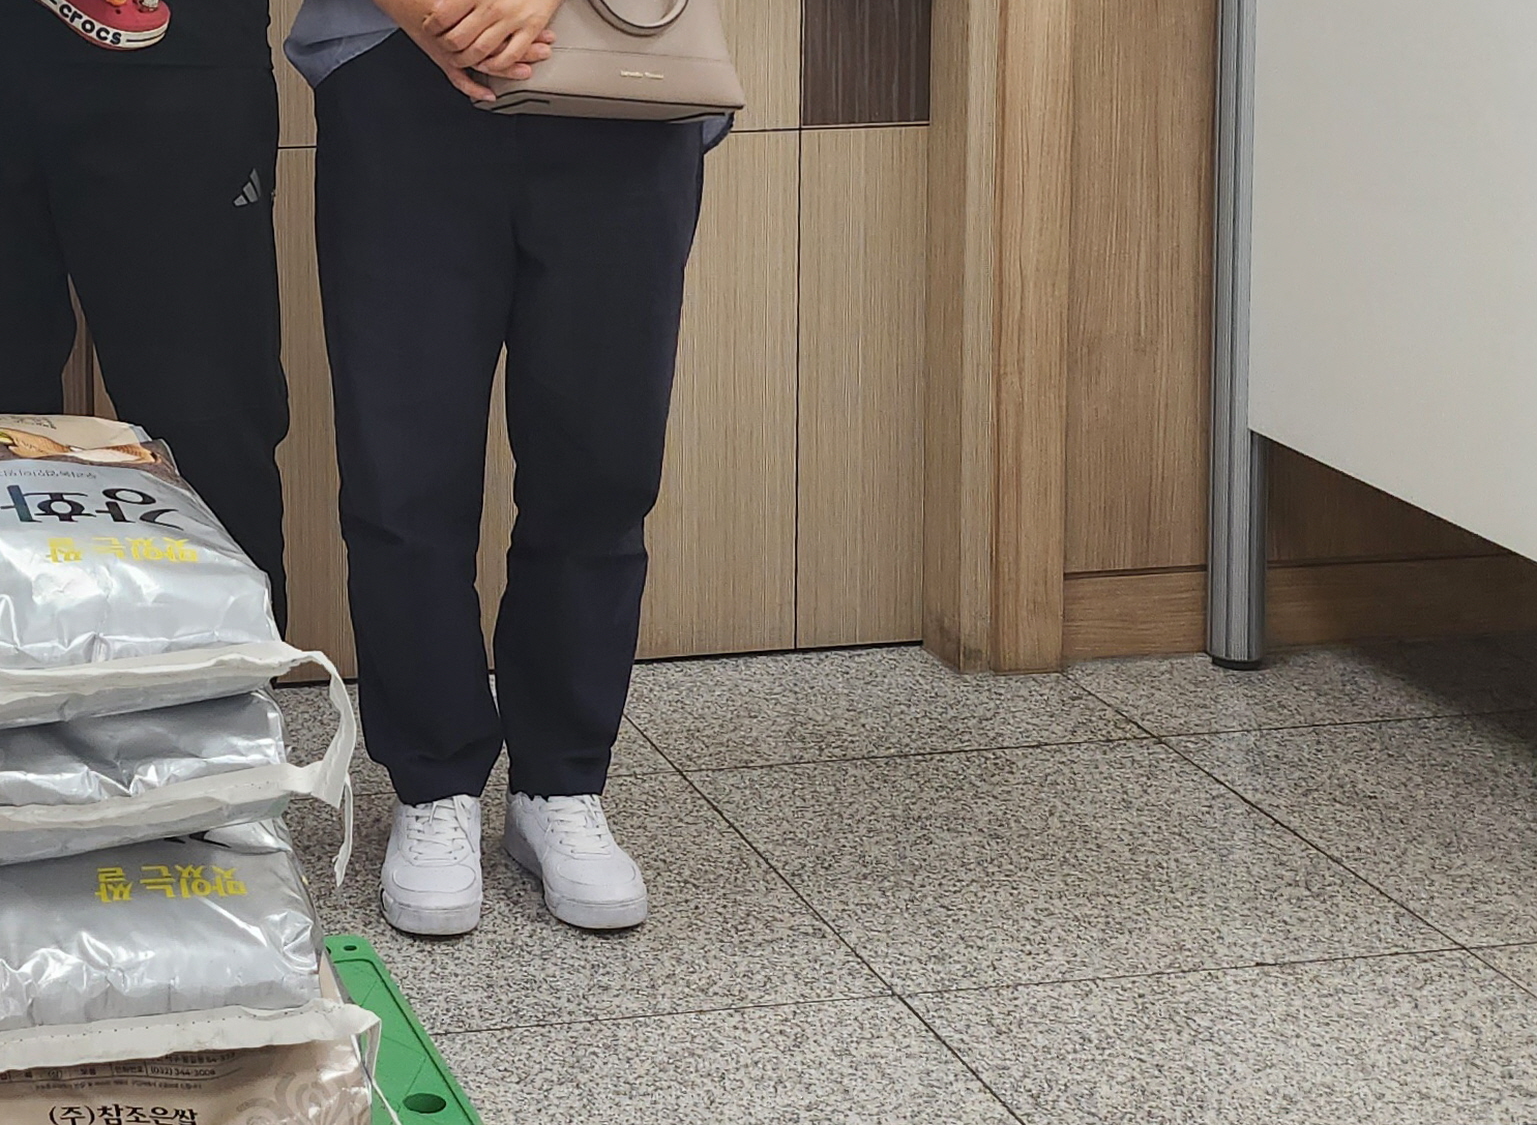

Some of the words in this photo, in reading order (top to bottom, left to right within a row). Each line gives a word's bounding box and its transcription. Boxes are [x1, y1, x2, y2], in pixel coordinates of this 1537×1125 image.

[59, 3, 123, 45] crocs
[46, 536, 84, 564] 쌀
[92, 537, 200, 564] 맛있는
[94, 866, 135, 904] 쌀
[139, 864, 249, 899] 맛있는
